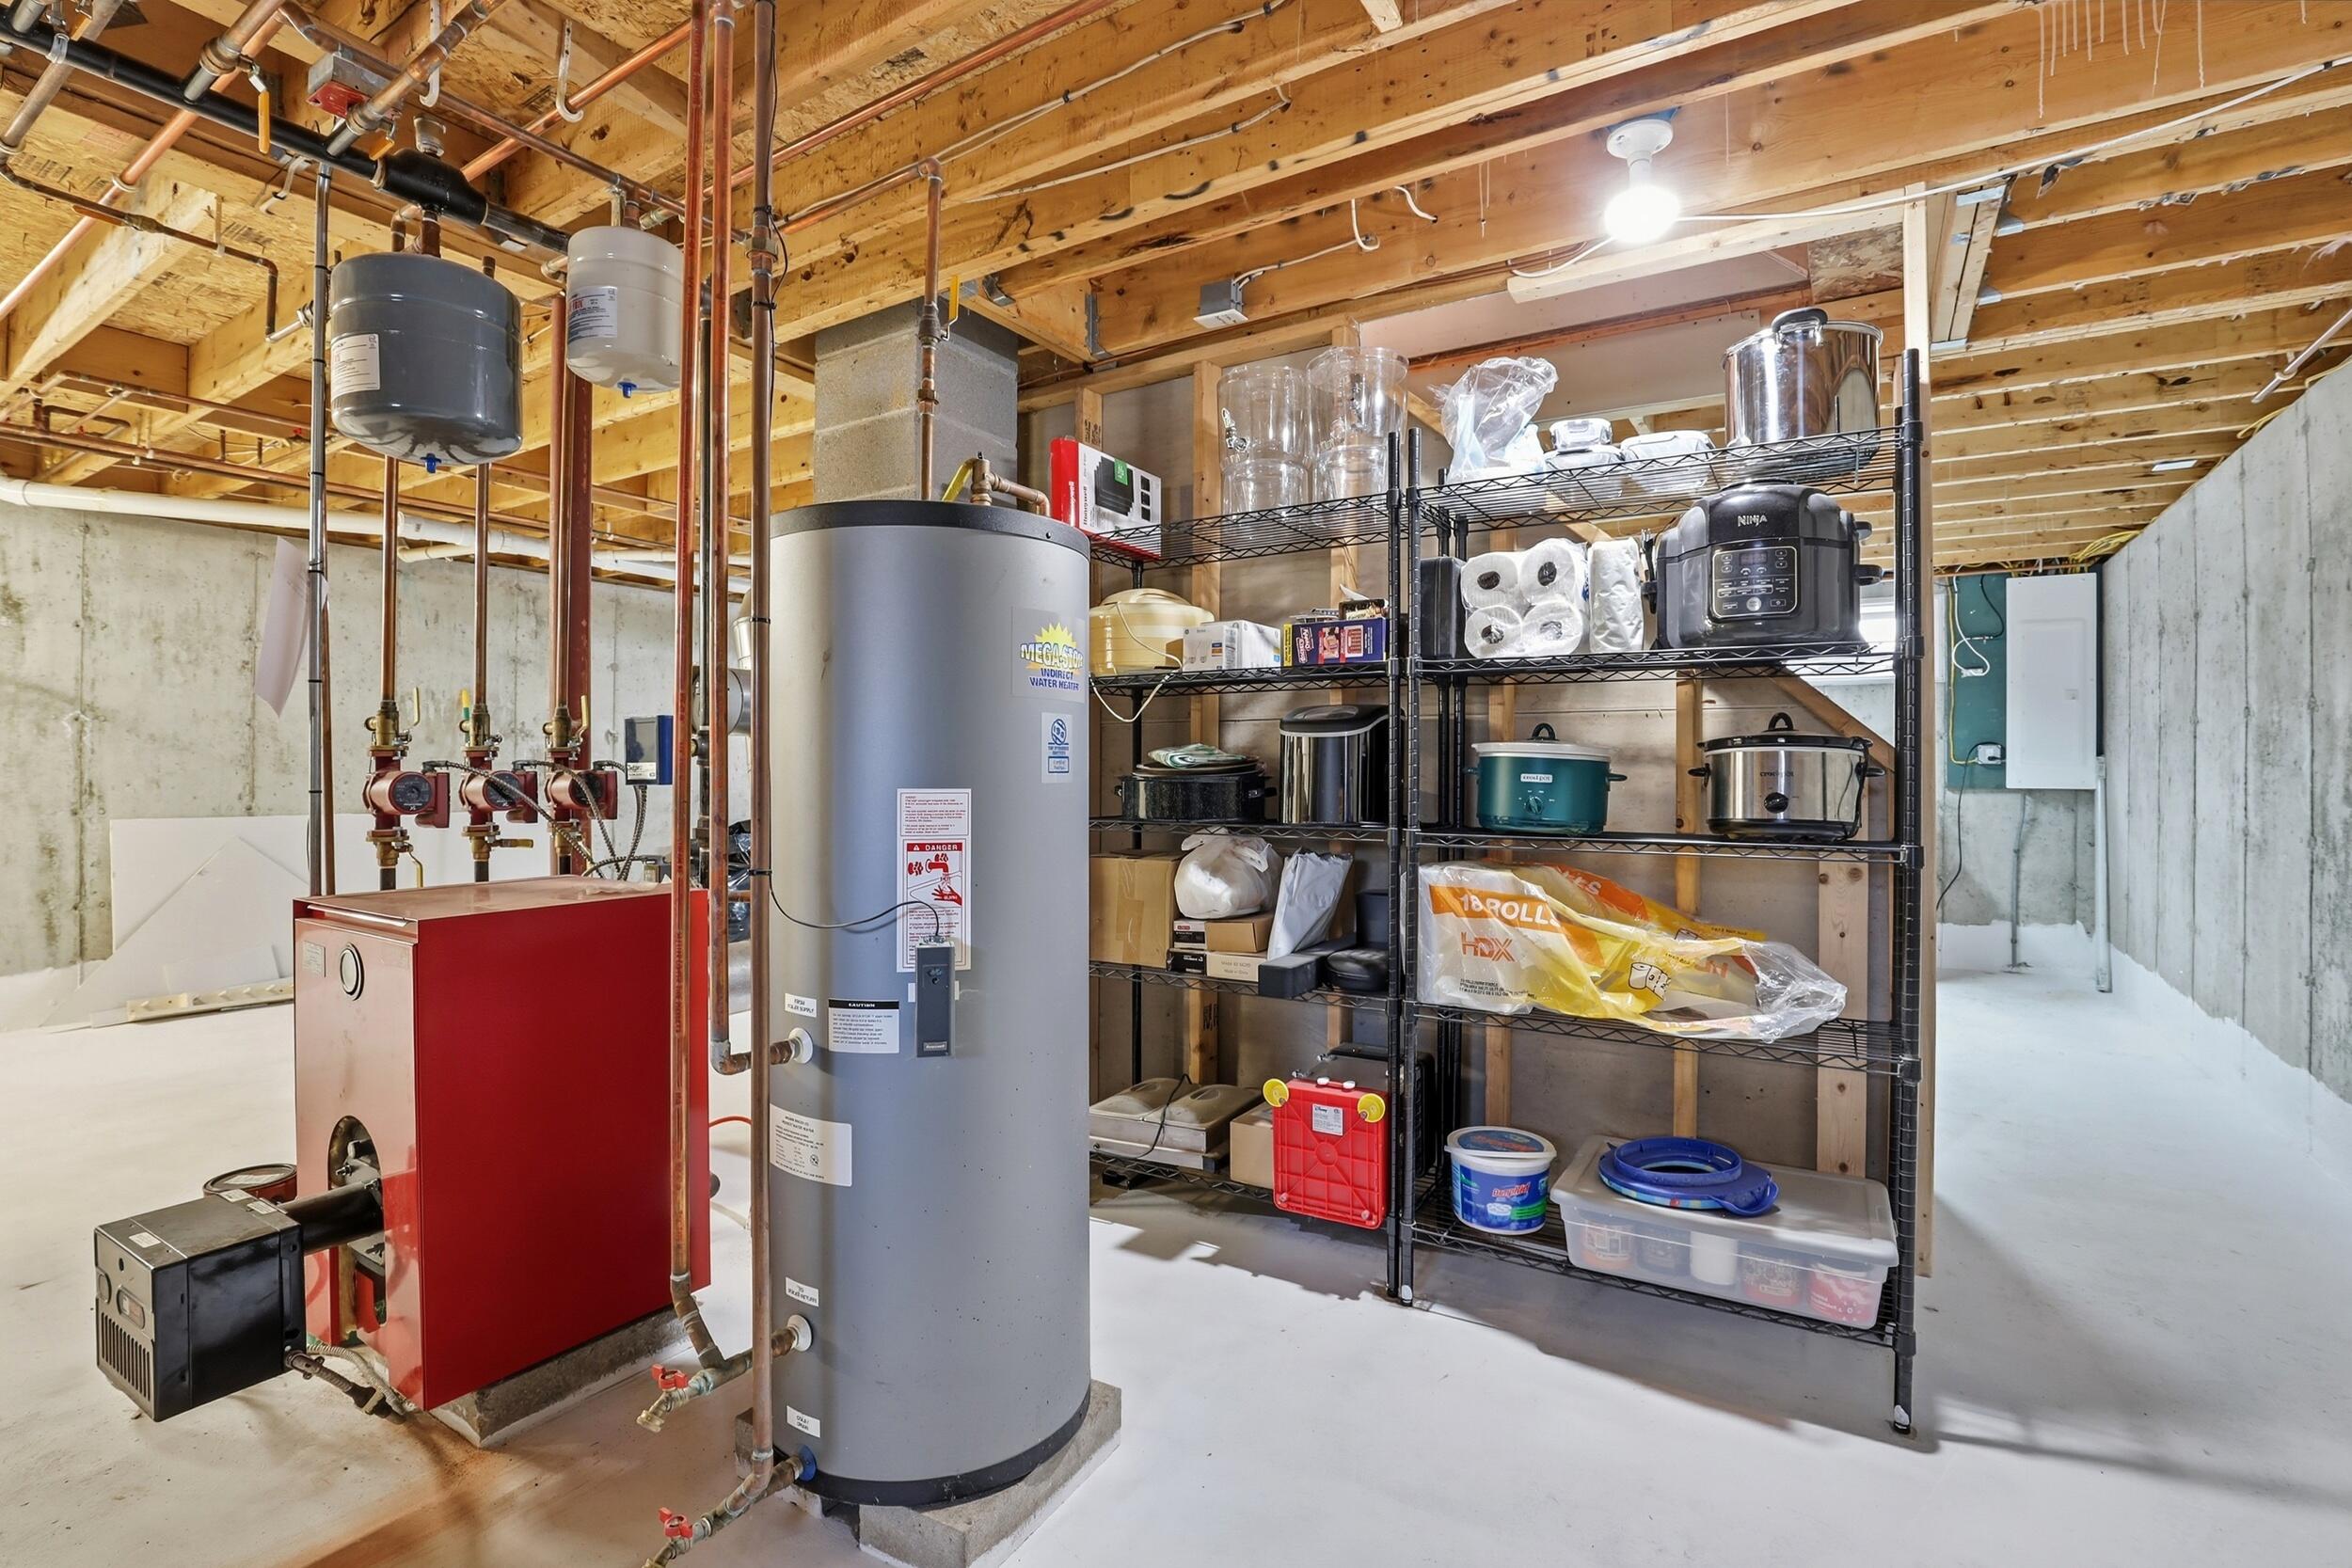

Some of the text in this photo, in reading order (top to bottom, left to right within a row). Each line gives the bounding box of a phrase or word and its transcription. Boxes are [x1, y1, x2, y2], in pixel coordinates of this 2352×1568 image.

[1041, 668, 1073, 680] INDIRECT
[1029, 676, 1080, 691] WATER HEATER
[1460, 894, 1484, 912] 18
[1461, 931, 1516, 962] HDX
